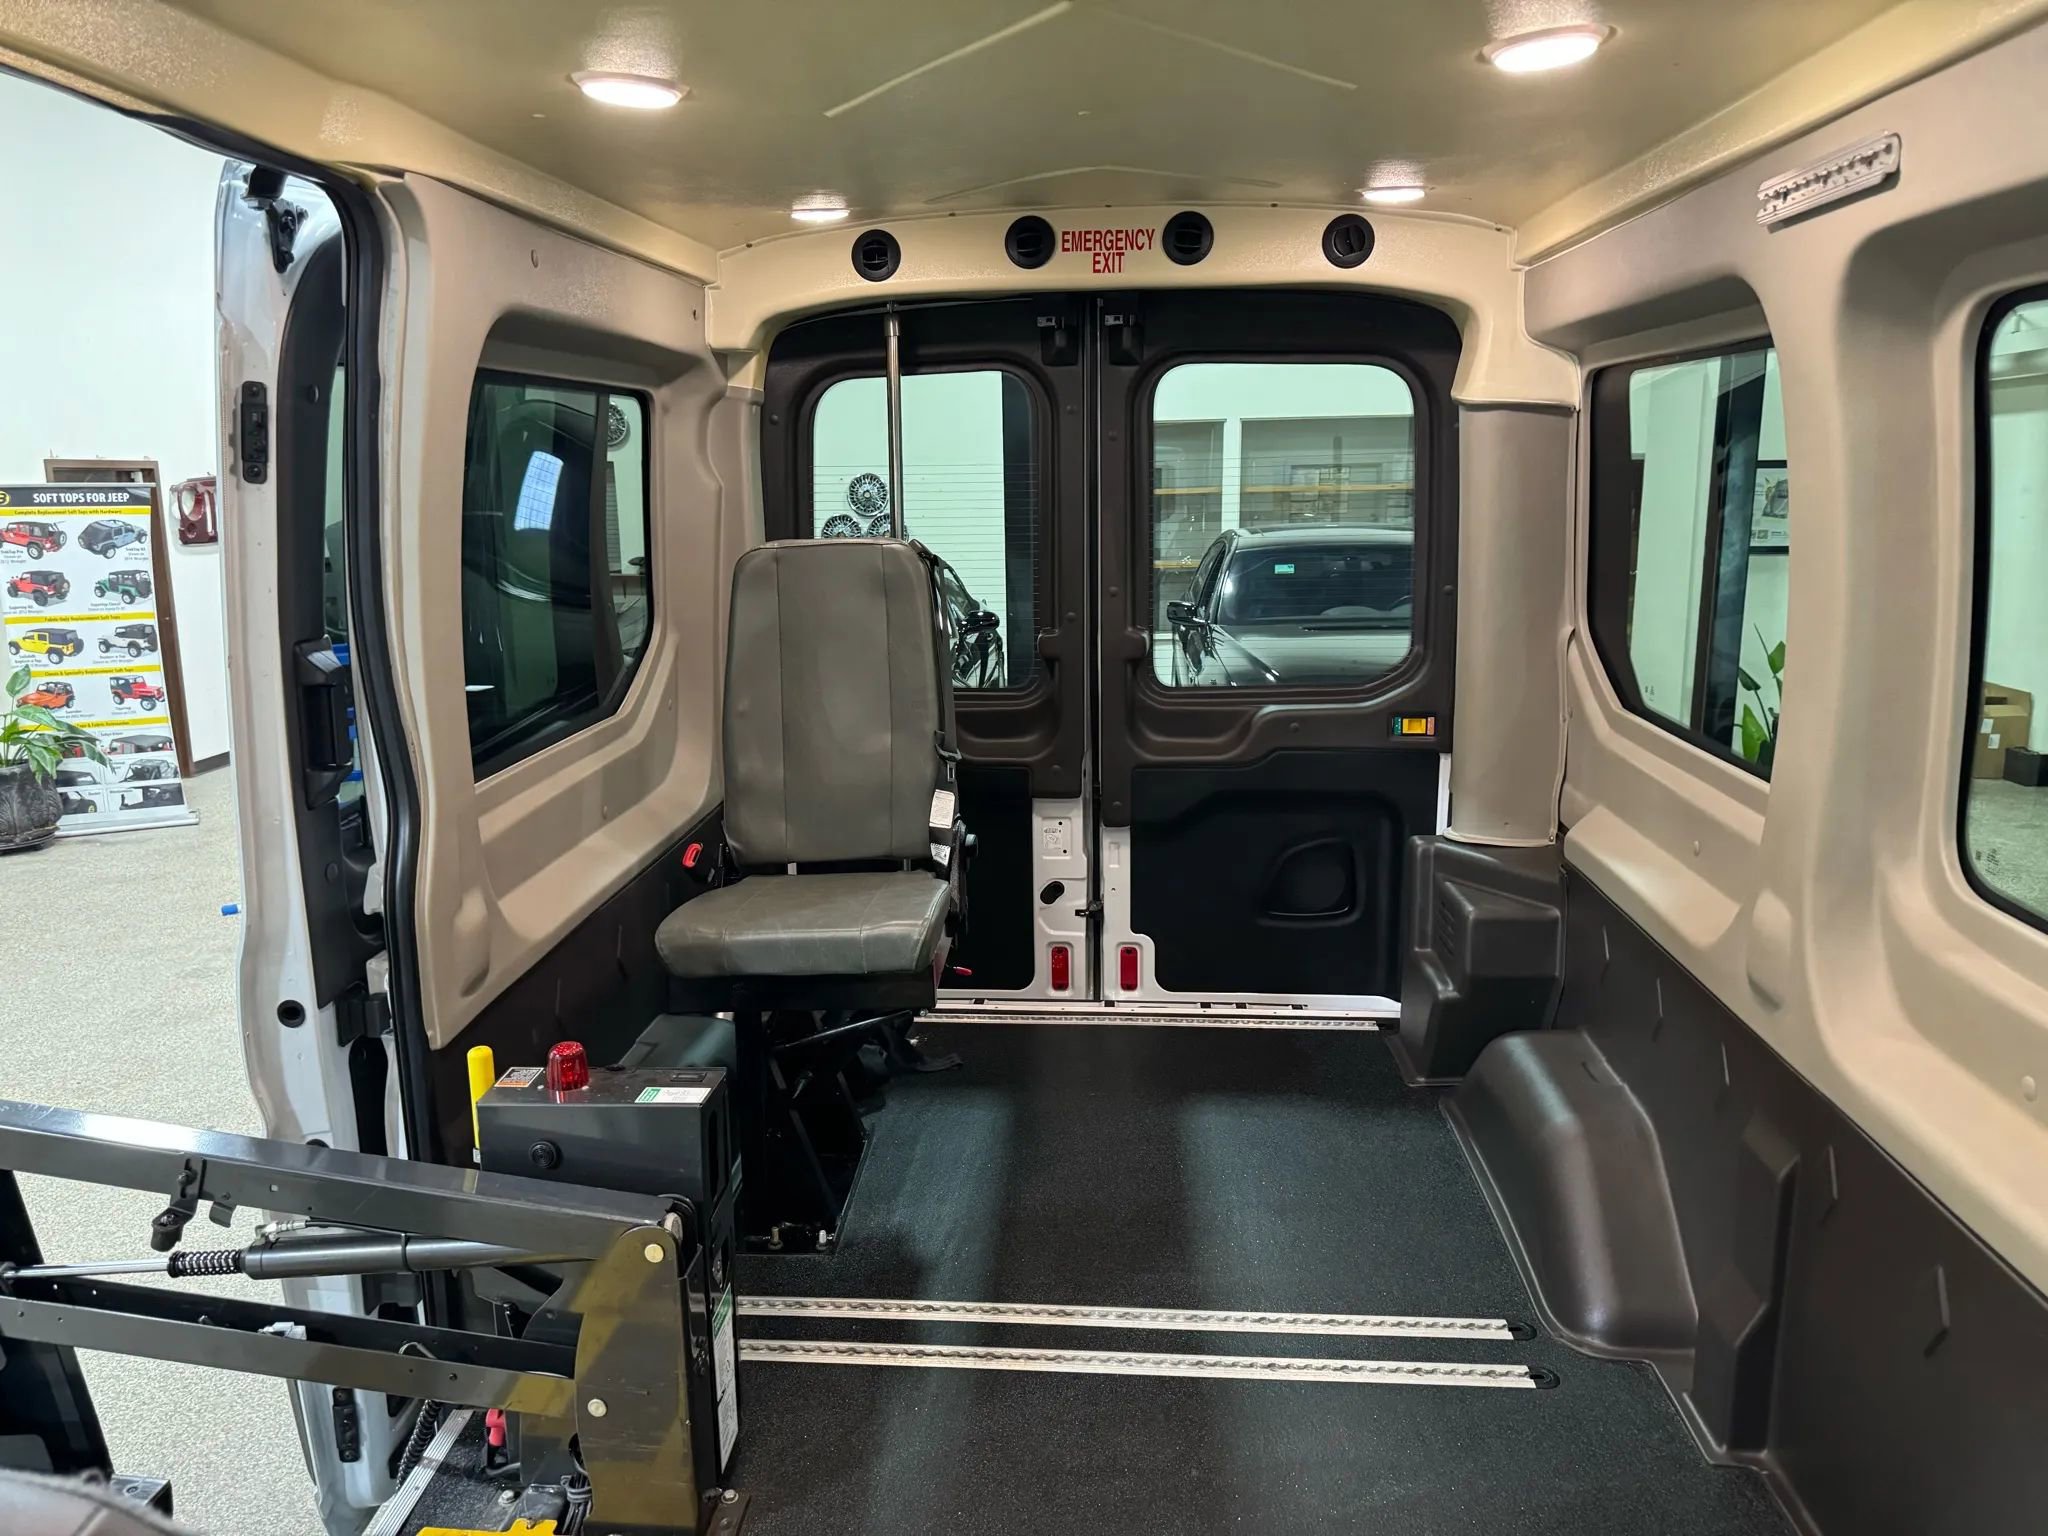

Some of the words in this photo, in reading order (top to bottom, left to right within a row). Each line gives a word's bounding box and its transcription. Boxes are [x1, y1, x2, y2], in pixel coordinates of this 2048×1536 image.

[1061, 229, 1155, 252] EMERGENCY
[1092, 252, 1125, 273] EXIT
[33, 493, 58, 503] SOFT
[59, 493, 85, 503] TOPS
[86, 493, 106, 503] FOR
[107, 492, 130, 502] JEEP
